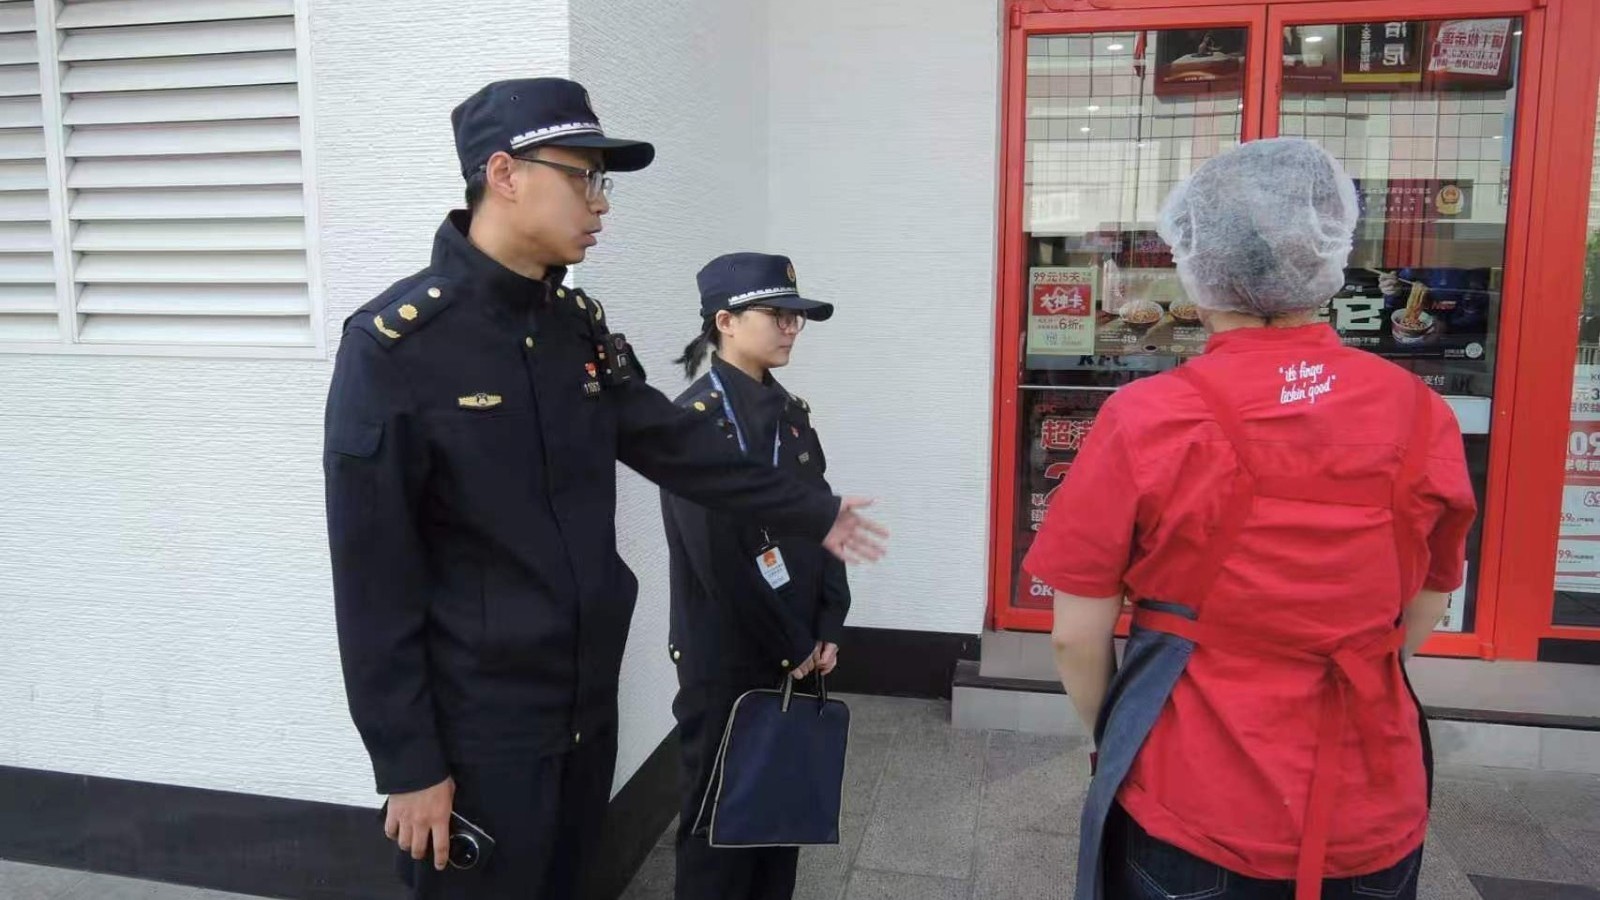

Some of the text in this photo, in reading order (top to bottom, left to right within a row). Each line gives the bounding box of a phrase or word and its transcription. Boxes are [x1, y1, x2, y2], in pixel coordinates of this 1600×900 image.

[1318, 296, 1385, 331] 它
[1299, 360, 1324, 383] finger
[1418, 375, 1445, 387] 支付
